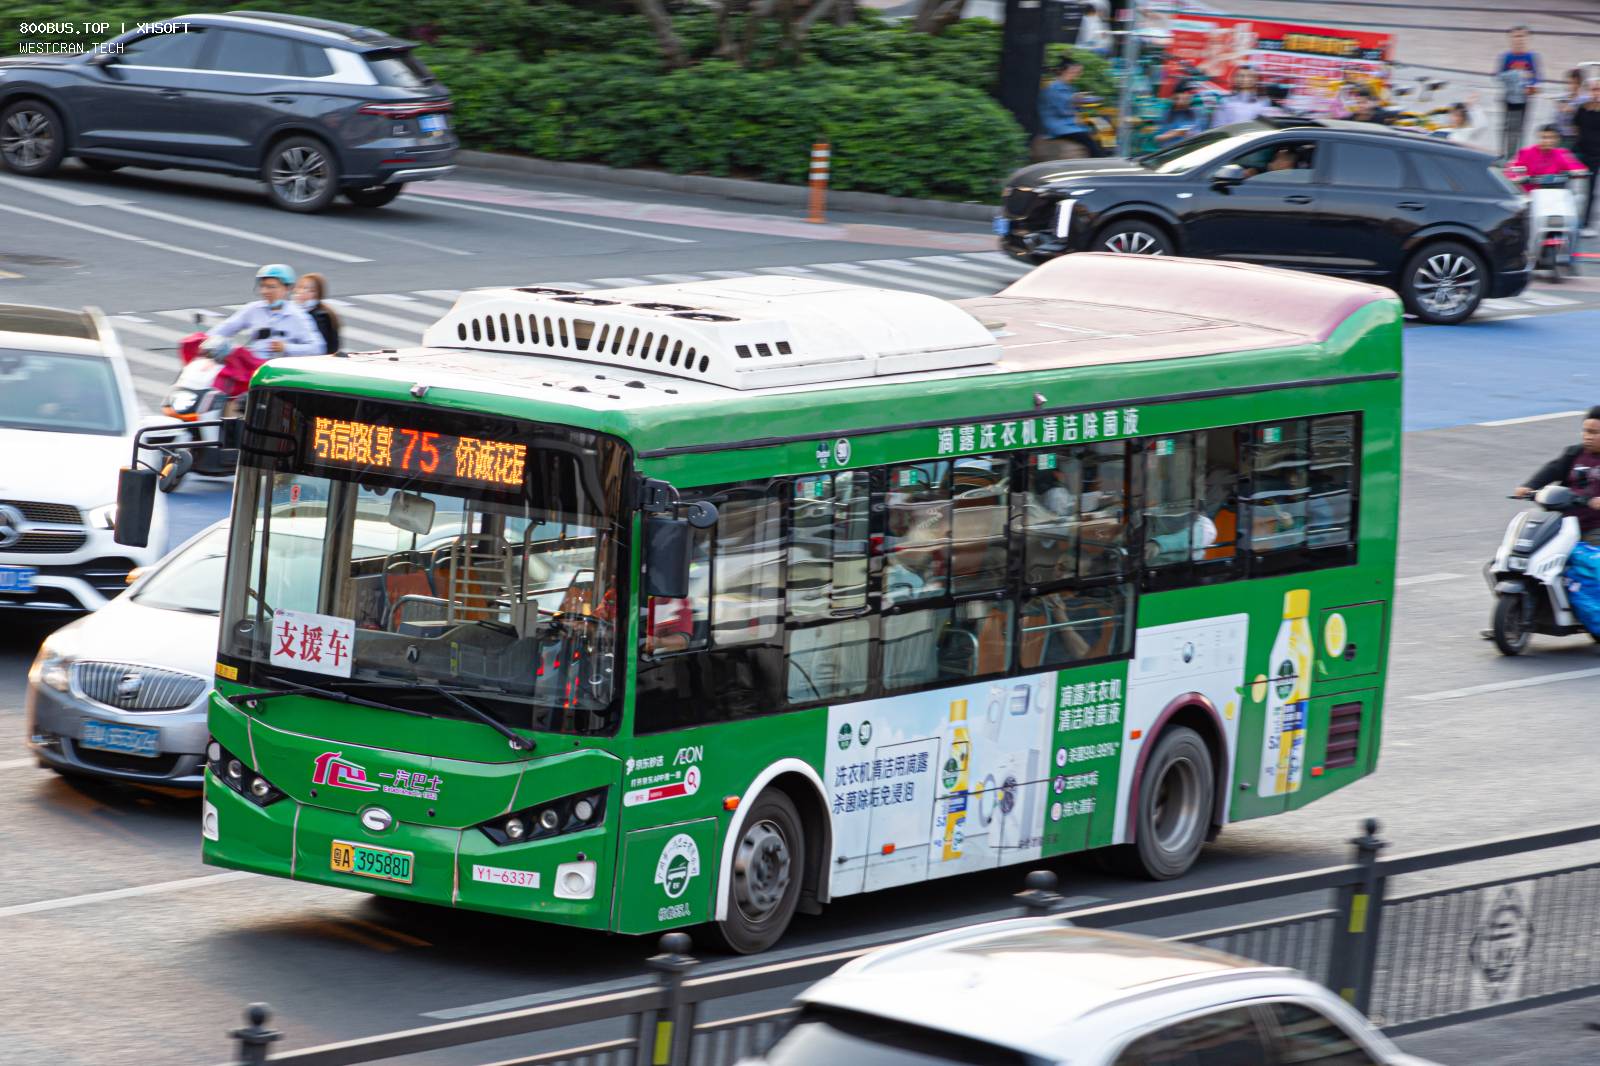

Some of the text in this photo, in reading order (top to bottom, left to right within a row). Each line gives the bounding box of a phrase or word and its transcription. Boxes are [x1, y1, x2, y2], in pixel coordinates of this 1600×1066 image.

[937, 407, 1140, 455] 滴露洗衣机清洁除菌液
[400, 428, 441, 473] 75
[273, 621, 349, 667] 支援车
[1060, 679, 1122, 708] 滴露洗衣机
[1058, 702, 1121, 732] 清洁除菌液
[379, 769, 443, 793] 一汽巴士
[477, 866, 534, 886] Y1-6337
